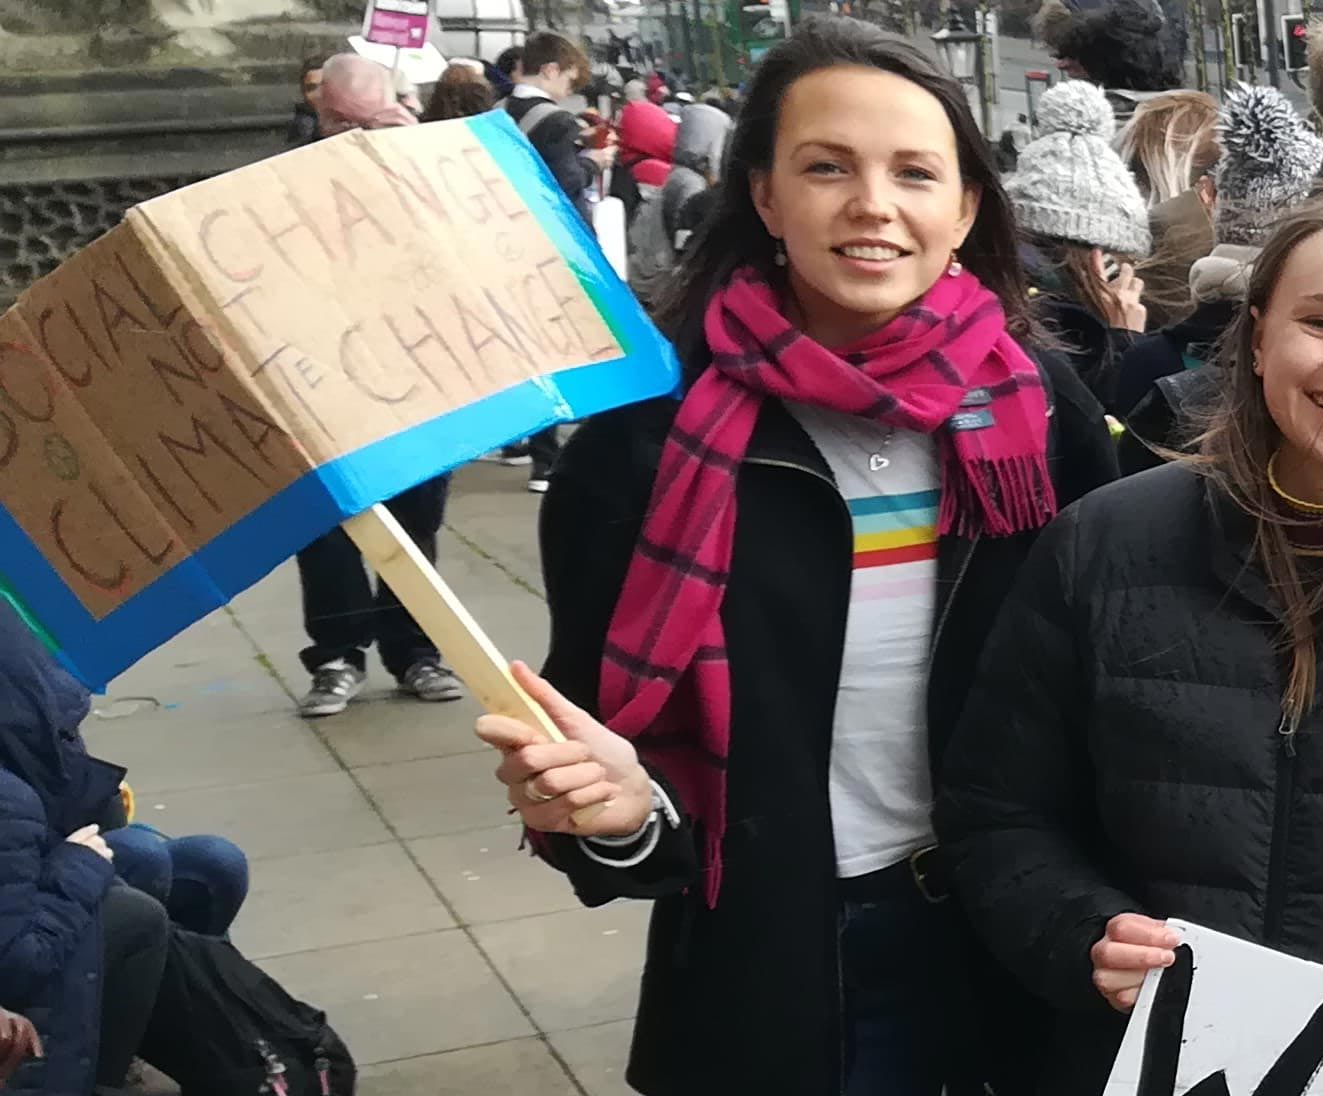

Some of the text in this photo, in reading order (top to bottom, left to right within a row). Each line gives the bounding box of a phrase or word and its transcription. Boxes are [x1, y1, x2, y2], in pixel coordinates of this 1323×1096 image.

[198, 147, 532, 283] CHANGE
[150, 286, 269, 405] NOT
[338, 256, 618, 404] CHANGE
